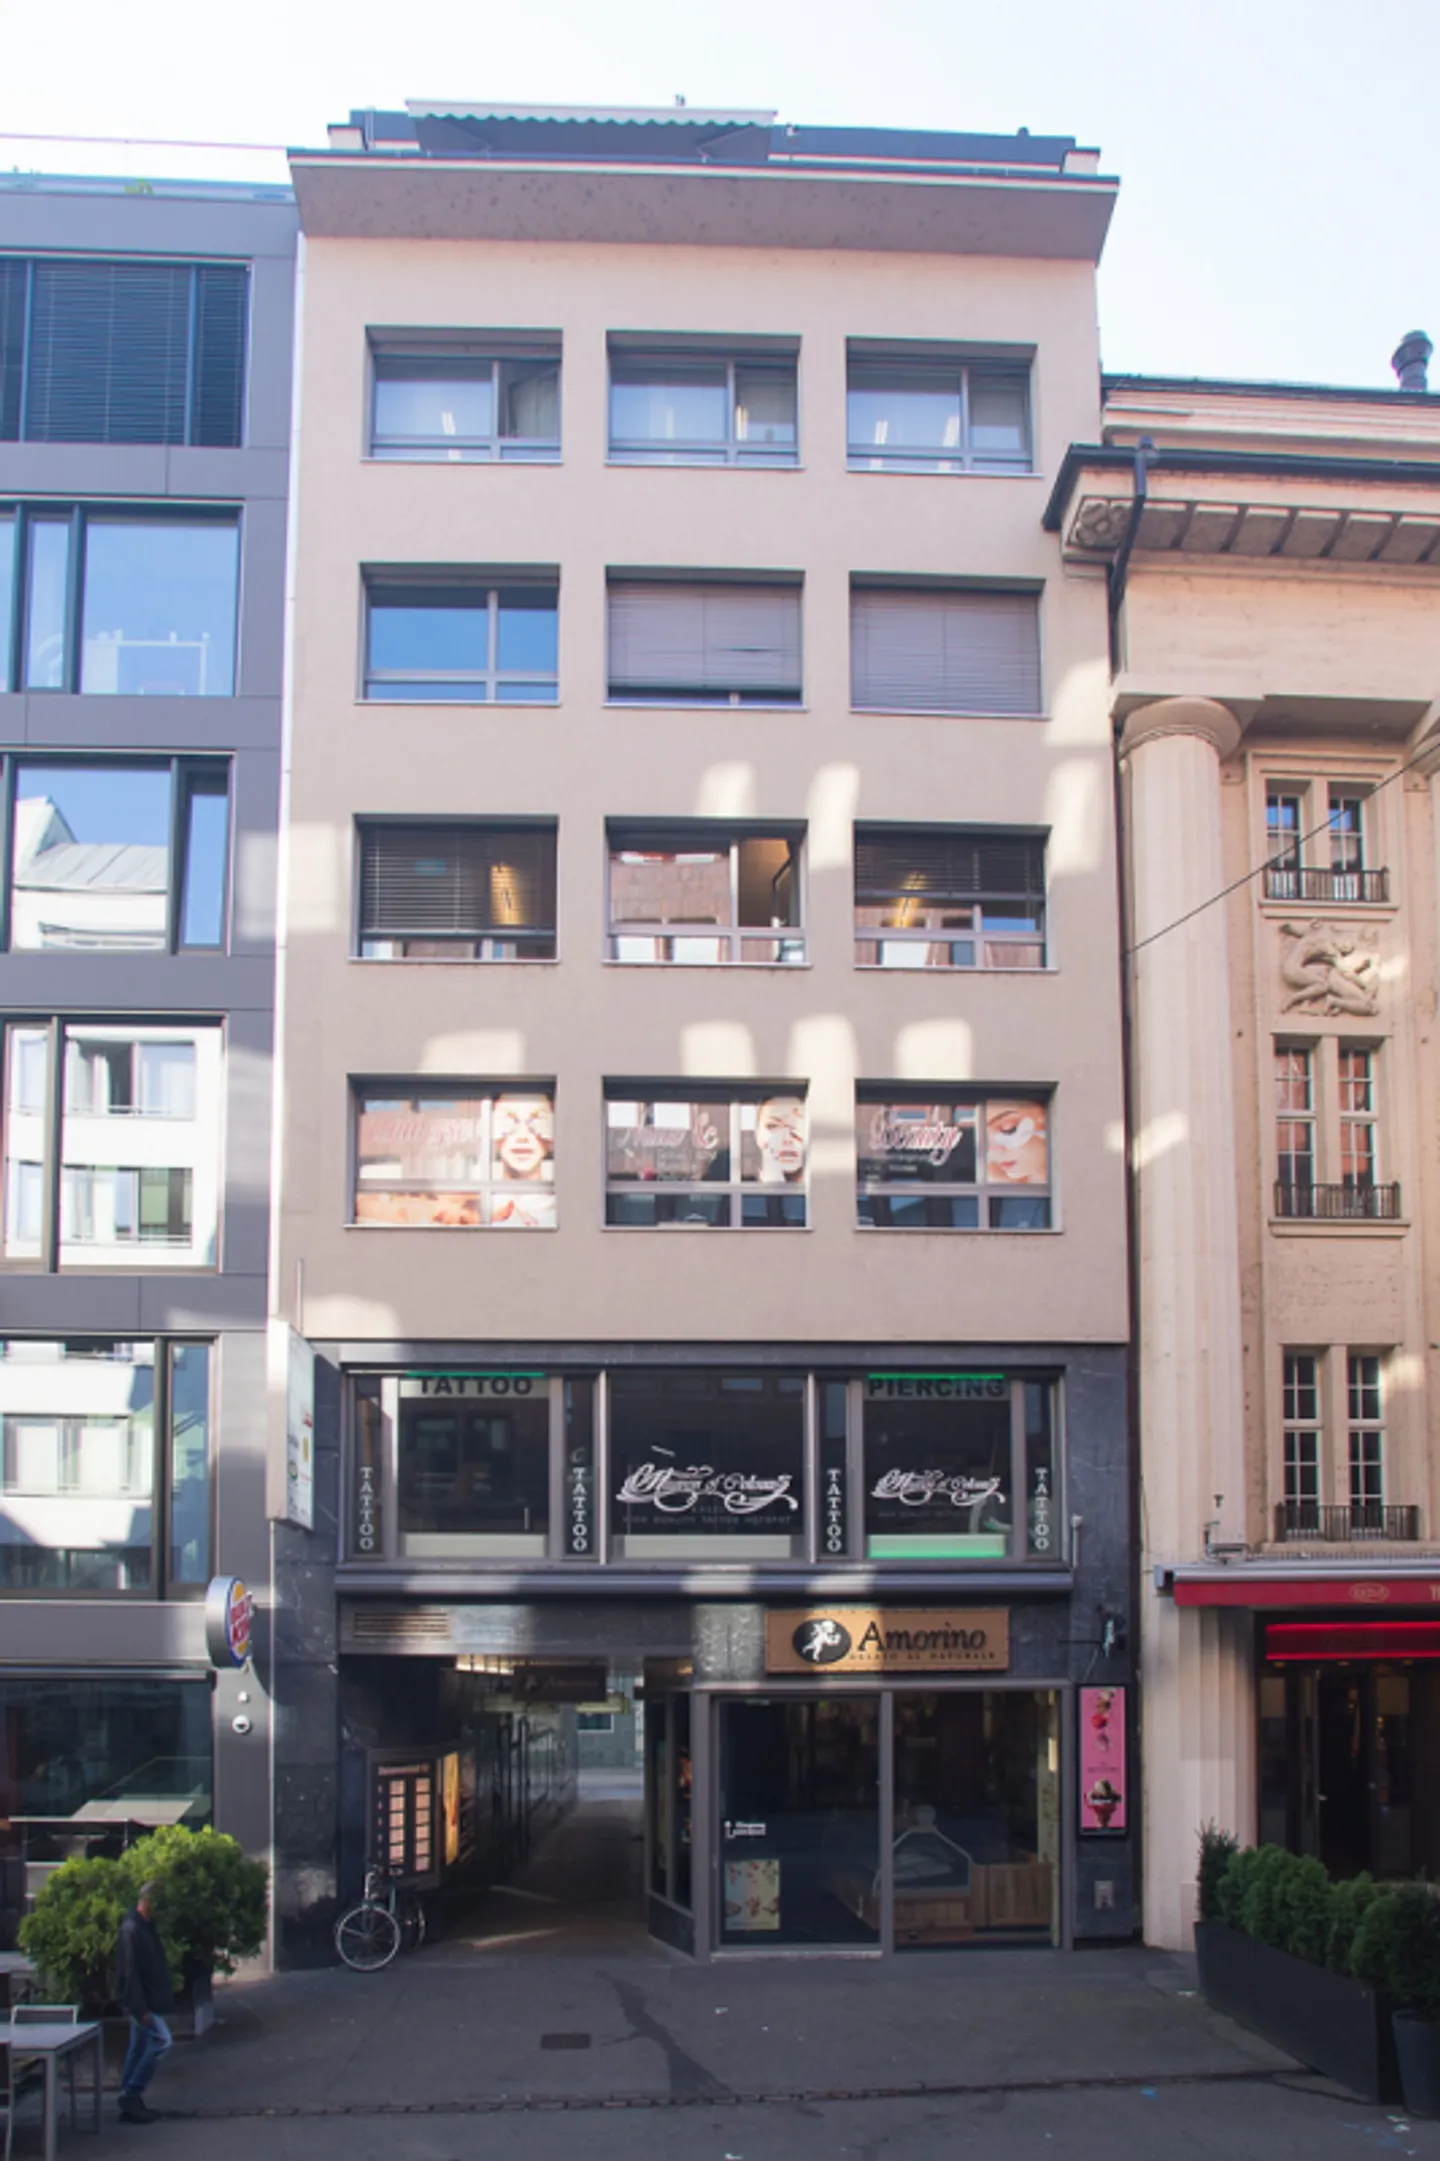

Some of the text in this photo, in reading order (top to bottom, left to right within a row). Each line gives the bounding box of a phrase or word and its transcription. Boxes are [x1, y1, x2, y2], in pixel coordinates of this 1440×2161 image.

[421, 1375, 533, 1396] TATTOO
[868, 1377, 1005, 1397] PIERCING
[360, 1466, 374, 1551] TATTOO
[572, 1467, 588, 1551] TATTOO
[826, 1468, 842, 1552] TATTOO
[1034, 1467, 1050, 1551] TATTOO
[848, 1651, 996, 1661] GELATO AL NATURALE
[857, 1620, 986, 1652] Amorino
